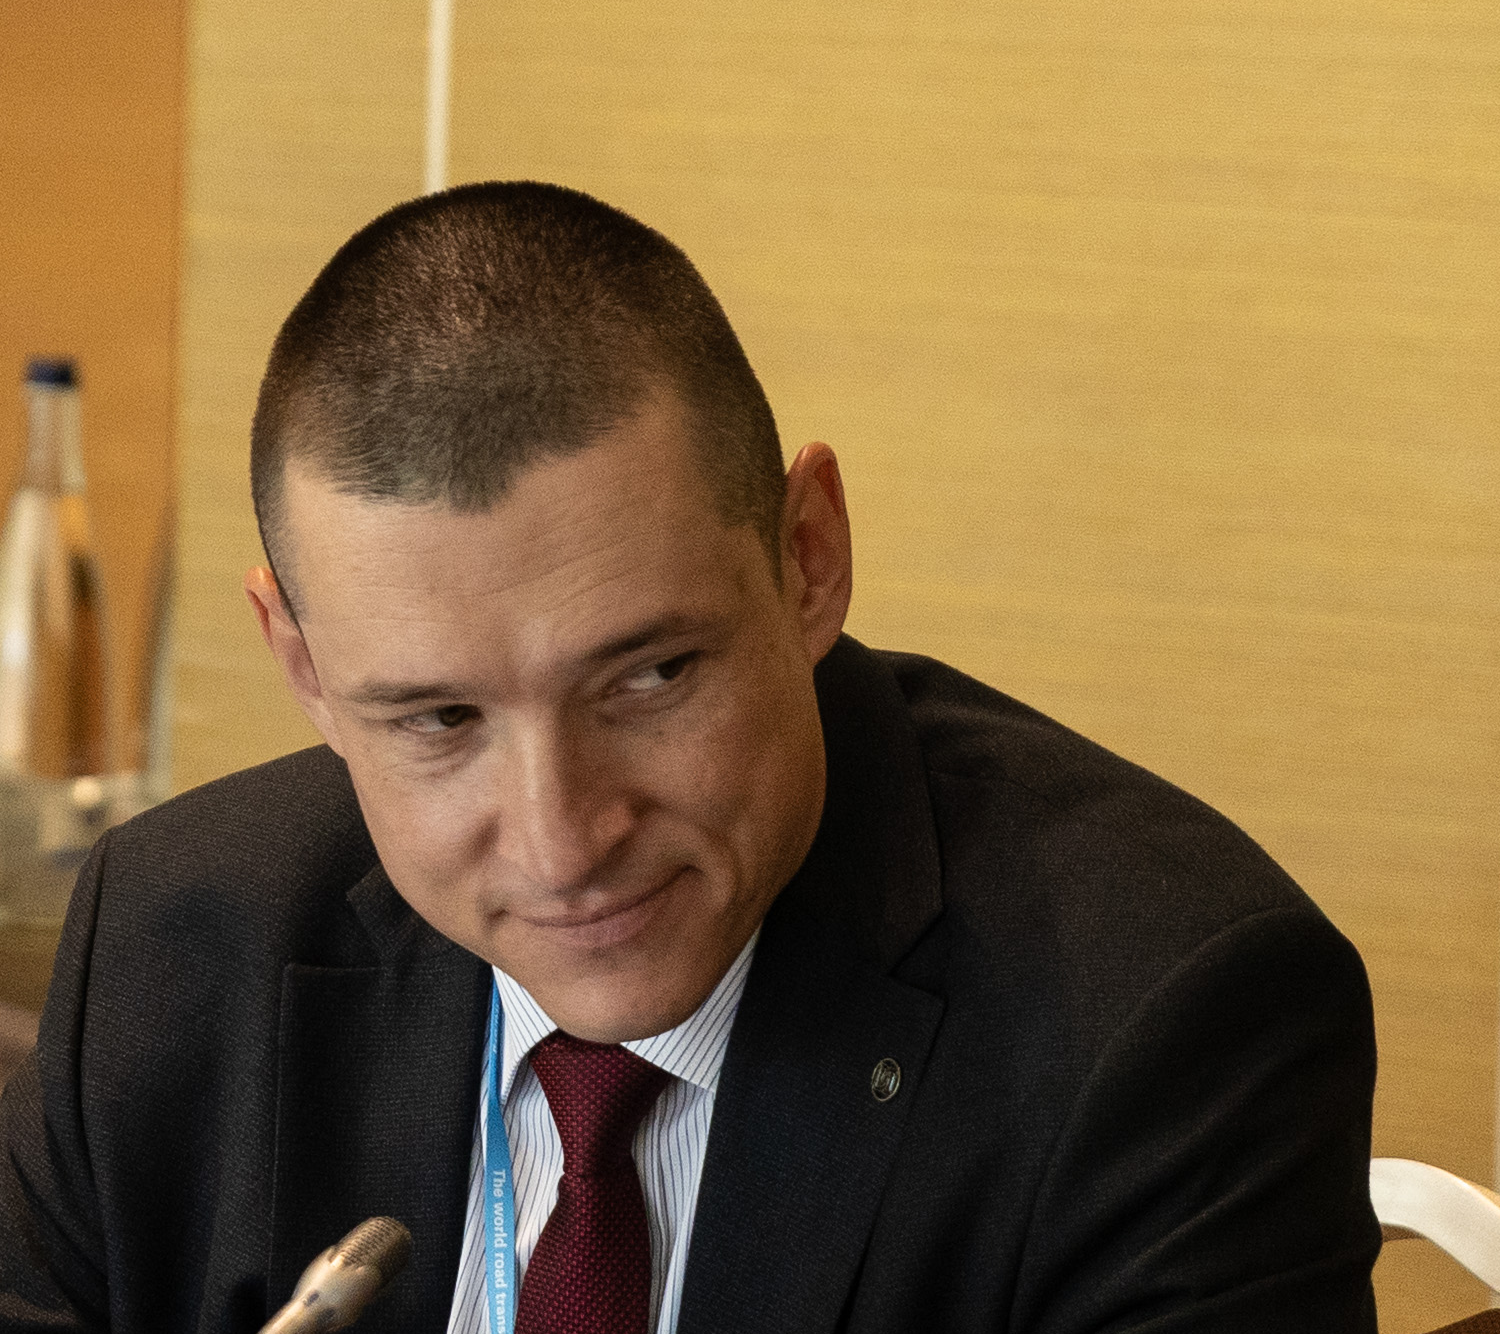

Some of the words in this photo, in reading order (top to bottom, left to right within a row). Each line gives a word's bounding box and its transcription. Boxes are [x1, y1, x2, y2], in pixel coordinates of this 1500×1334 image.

[492, 1168, 507, 1198] The
[493, 1202, 508, 1248] world
[494, 1253, 509, 1289] road
